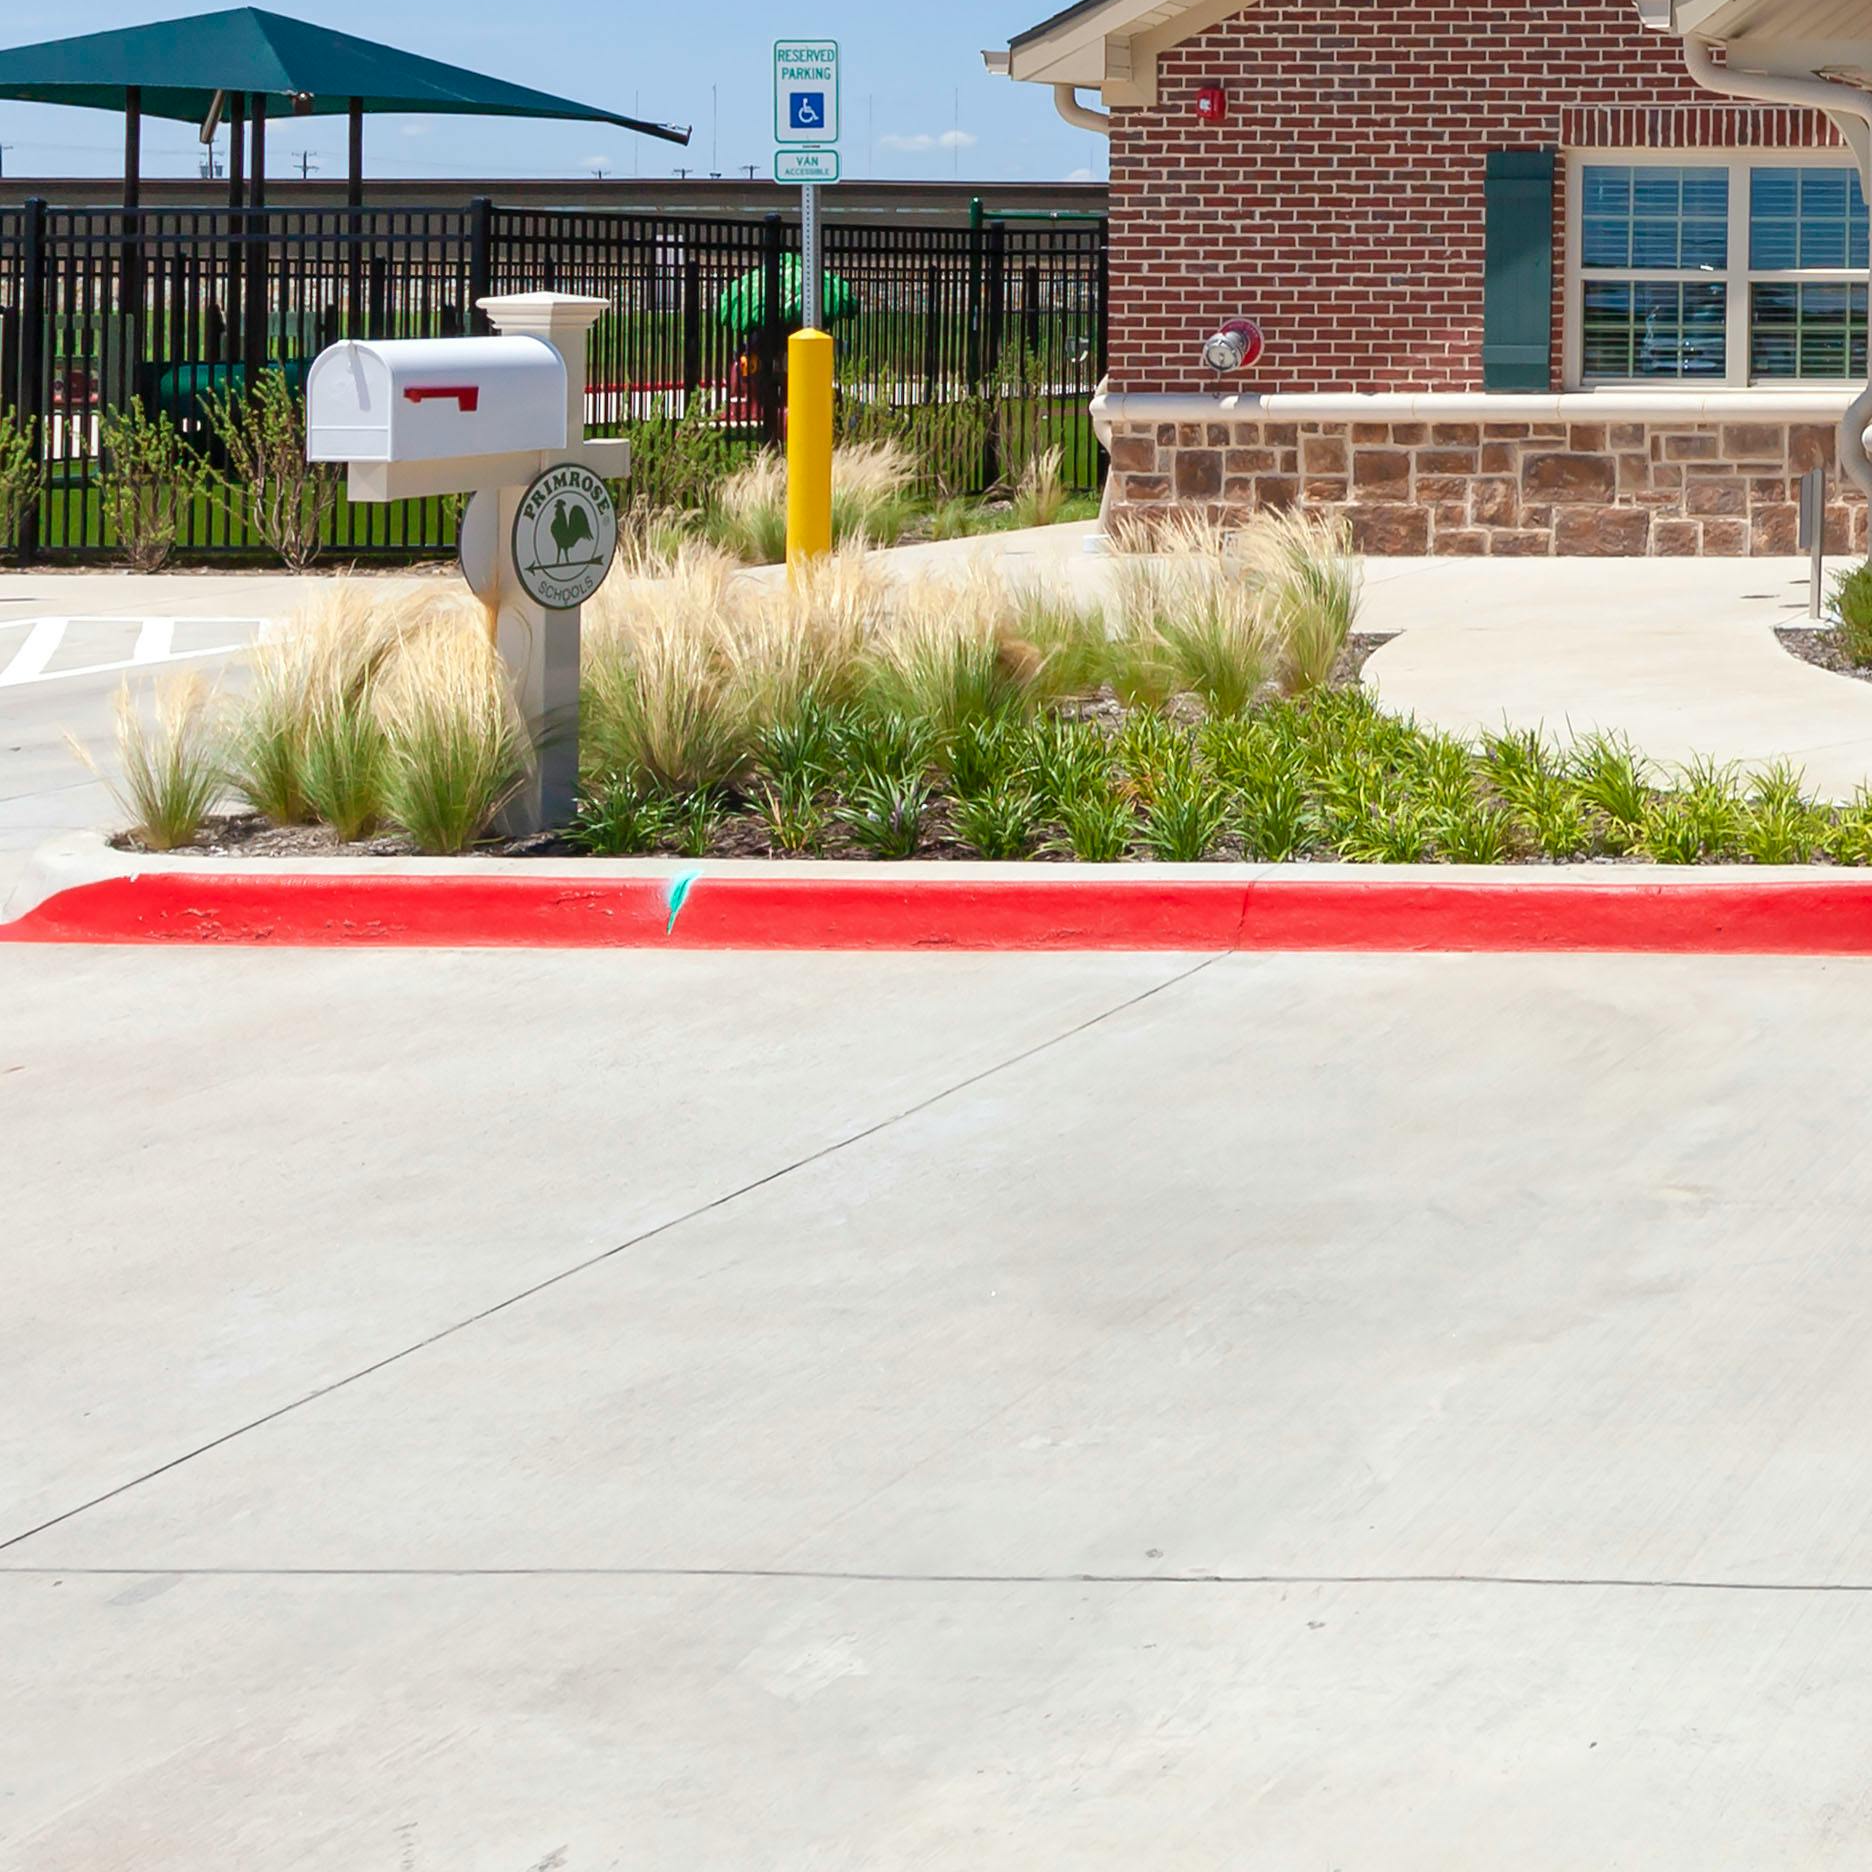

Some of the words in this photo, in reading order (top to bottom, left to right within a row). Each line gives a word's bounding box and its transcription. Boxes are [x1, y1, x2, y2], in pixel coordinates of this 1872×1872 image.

[777, 48, 835, 63] RESERVED
[781, 66, 831, 80] PARKING
[796, 156, 819, 166] VAN
[784, 167, 830, 176] ACCESSIBLE
[537, 575, 594, 602] SCHOOLS
